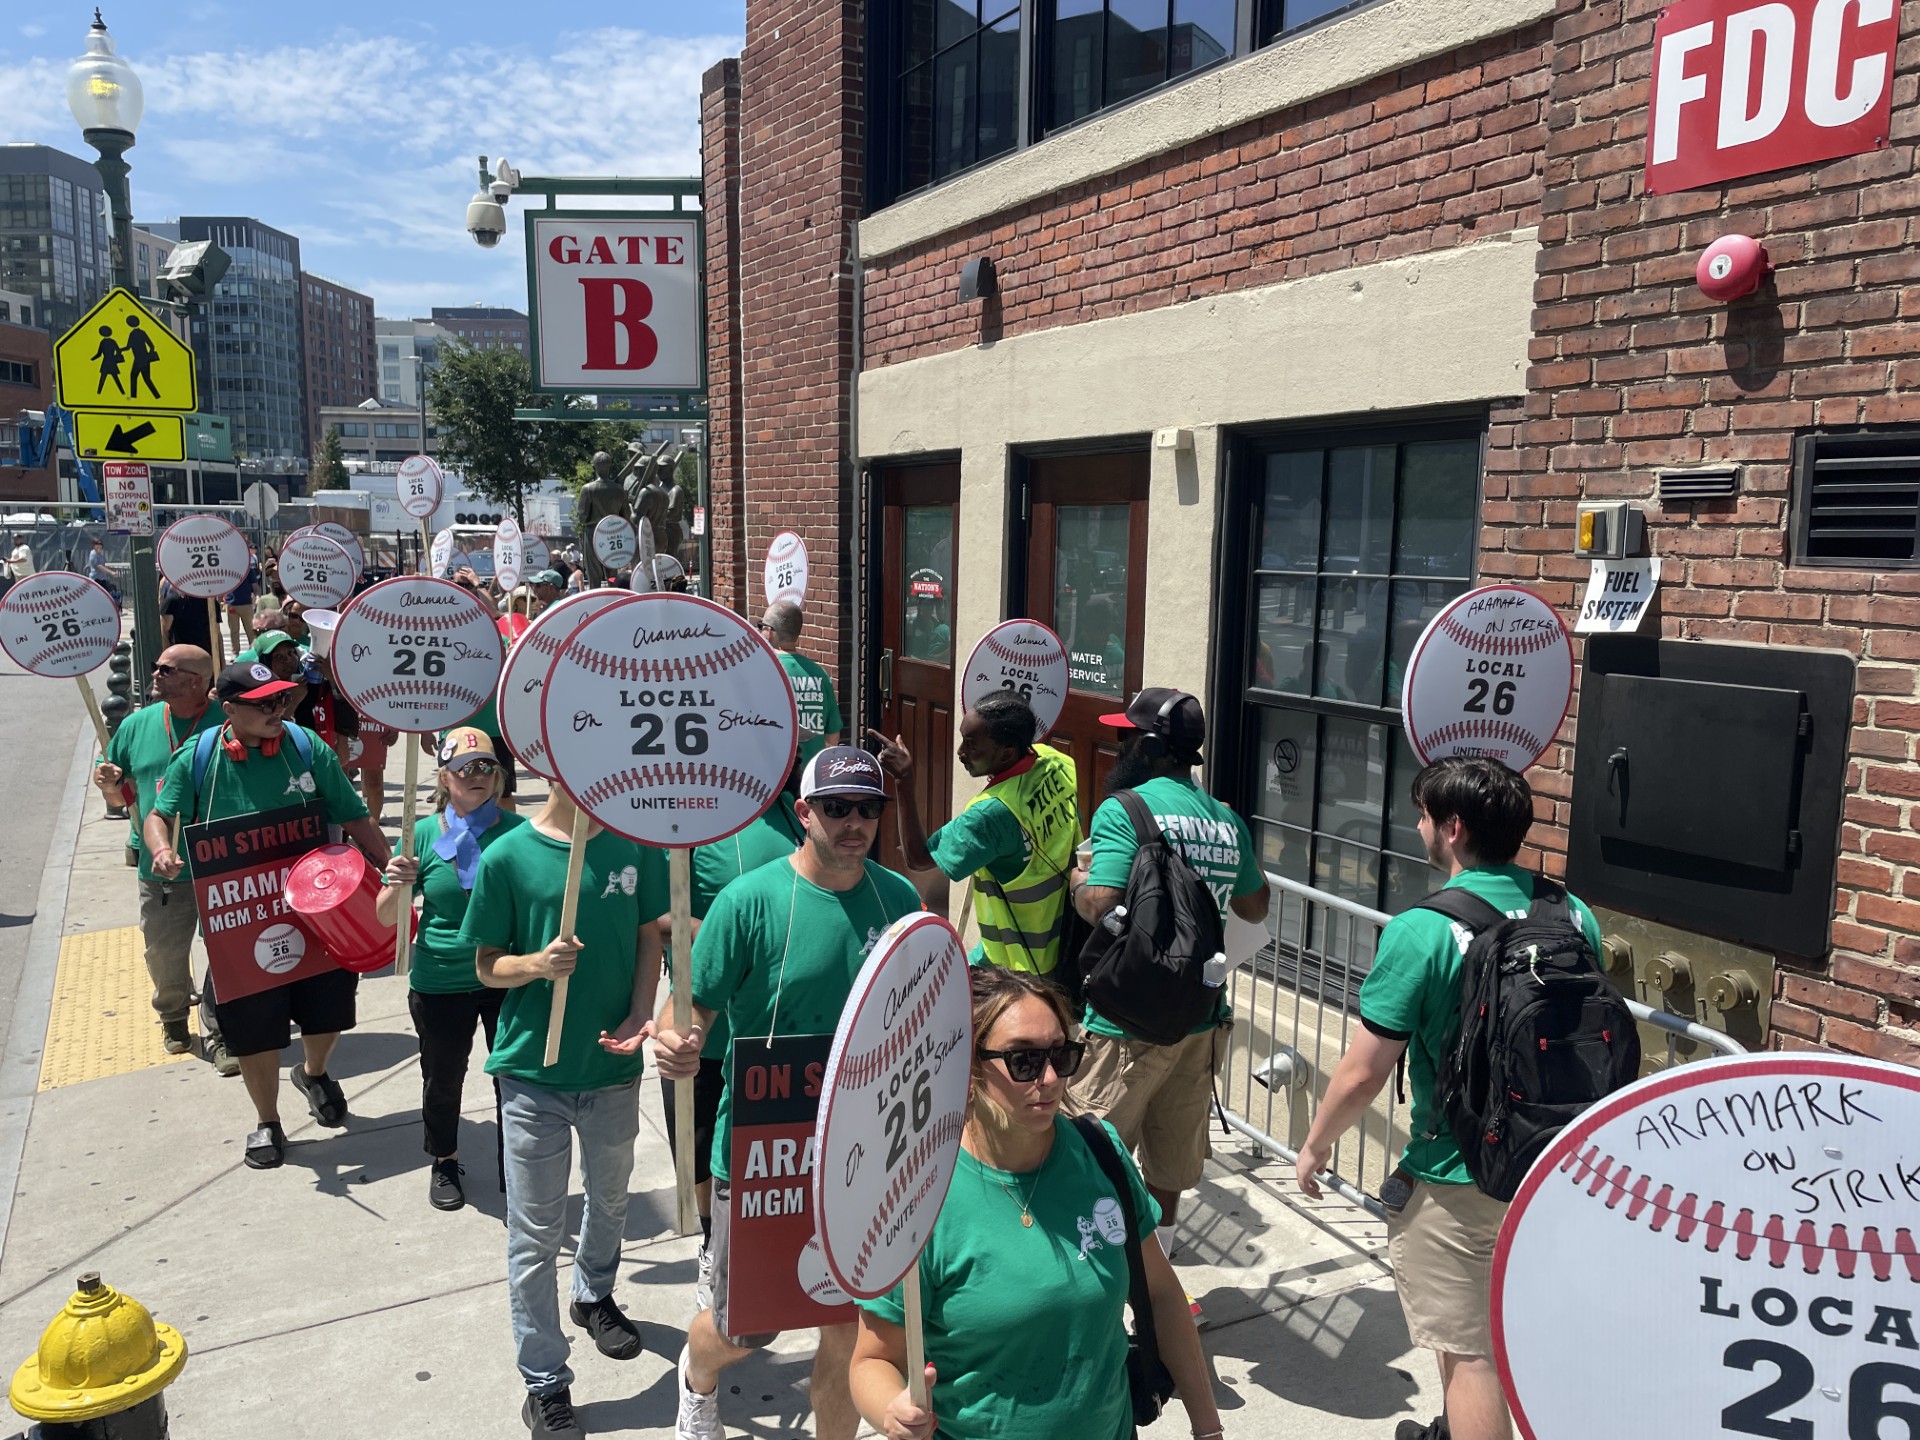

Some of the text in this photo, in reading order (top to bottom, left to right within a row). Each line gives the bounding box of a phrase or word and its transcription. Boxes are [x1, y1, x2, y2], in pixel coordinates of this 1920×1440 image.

[1653, 0, 1893, 166] FDC
[549, 235, 684, 265] GATE
[578, 277, 658, 370] B
[106, 466, 146, 475] TOW ZONE
[119, 481, 135, 490] NO
[410, 484, 424, 495] 26
[187, 545, 221, 553] LOCAL
[609, 540, 623, 551] 26
[191, 553, 220, 568] 26
[301, 561, 329, 570] LOCAL
[502, 552, 512, 565] 26
[776, 562, 794, 573] LOCAL
[303, 568, 327, 583] 26
[777, 570, 792, 589] 26
[1603, 571, 1640, 594] FUEL
[913, 582, 940, 592] NATION'S
[32, 608, 79, 624] LOCAL
[1467, 595, 1527, 618] ARAMARK
[1584, 599, 1645, 621] SYSTEM
[41, 617, 81, 642] 26
[1485, 618, 1553, 634] ON STRIKE
[389, 634, 452, 648] LOCAL
[351, 643, 372, 662] On
[1071, 651, 1103, 666] WATER
[392, 649, 446, 677] 26
[1466, 658, 1526, 678] LOCAL
[1000, 665, 1039, 682] LOCAL
[1069, 667, 1107, 684] SERVICE
[388, 701, 448, 711] UNITEHERE!
[620, 690, 715, 707] LOCAL
[1463, 677, 1517, 716] 26
[573, 710, 602, 732] On
[630, 712, 709, 756] 26
[1452, 745, 1509, 760] UNITEHERE!
[829, 760, 874, 778] Boston
[630, 797, 719, 810] UNITEHERE!
[195, 815, 322, 863] ON STRIKE!
[208, 907, 252, 933] MGM
[256, 903, 268, 920] &
[269, 939, 290, 949] LOCAL
[272, 944, 290, 957] 26
[745, 1064, 791, 1100] ON
[876, 1033, 936, 1115] LOCAL
[884, 1067, 932, 1175] 26
[1635, 1082, 1883, 1151] ARAMARK
[1743, 1145, 1796, 1174] ON
[1791, 1162, 1920, 1214] STRIK
[741, 1187, 804, 1219] MGM
[885, 1163, 939, 1247] UNITEHERE!
[1106, 1218, 1118, 1229] 26
[1699, 1276, 1920, 1350] LOCA
[1721, 1338, 1920, 1440] 26
